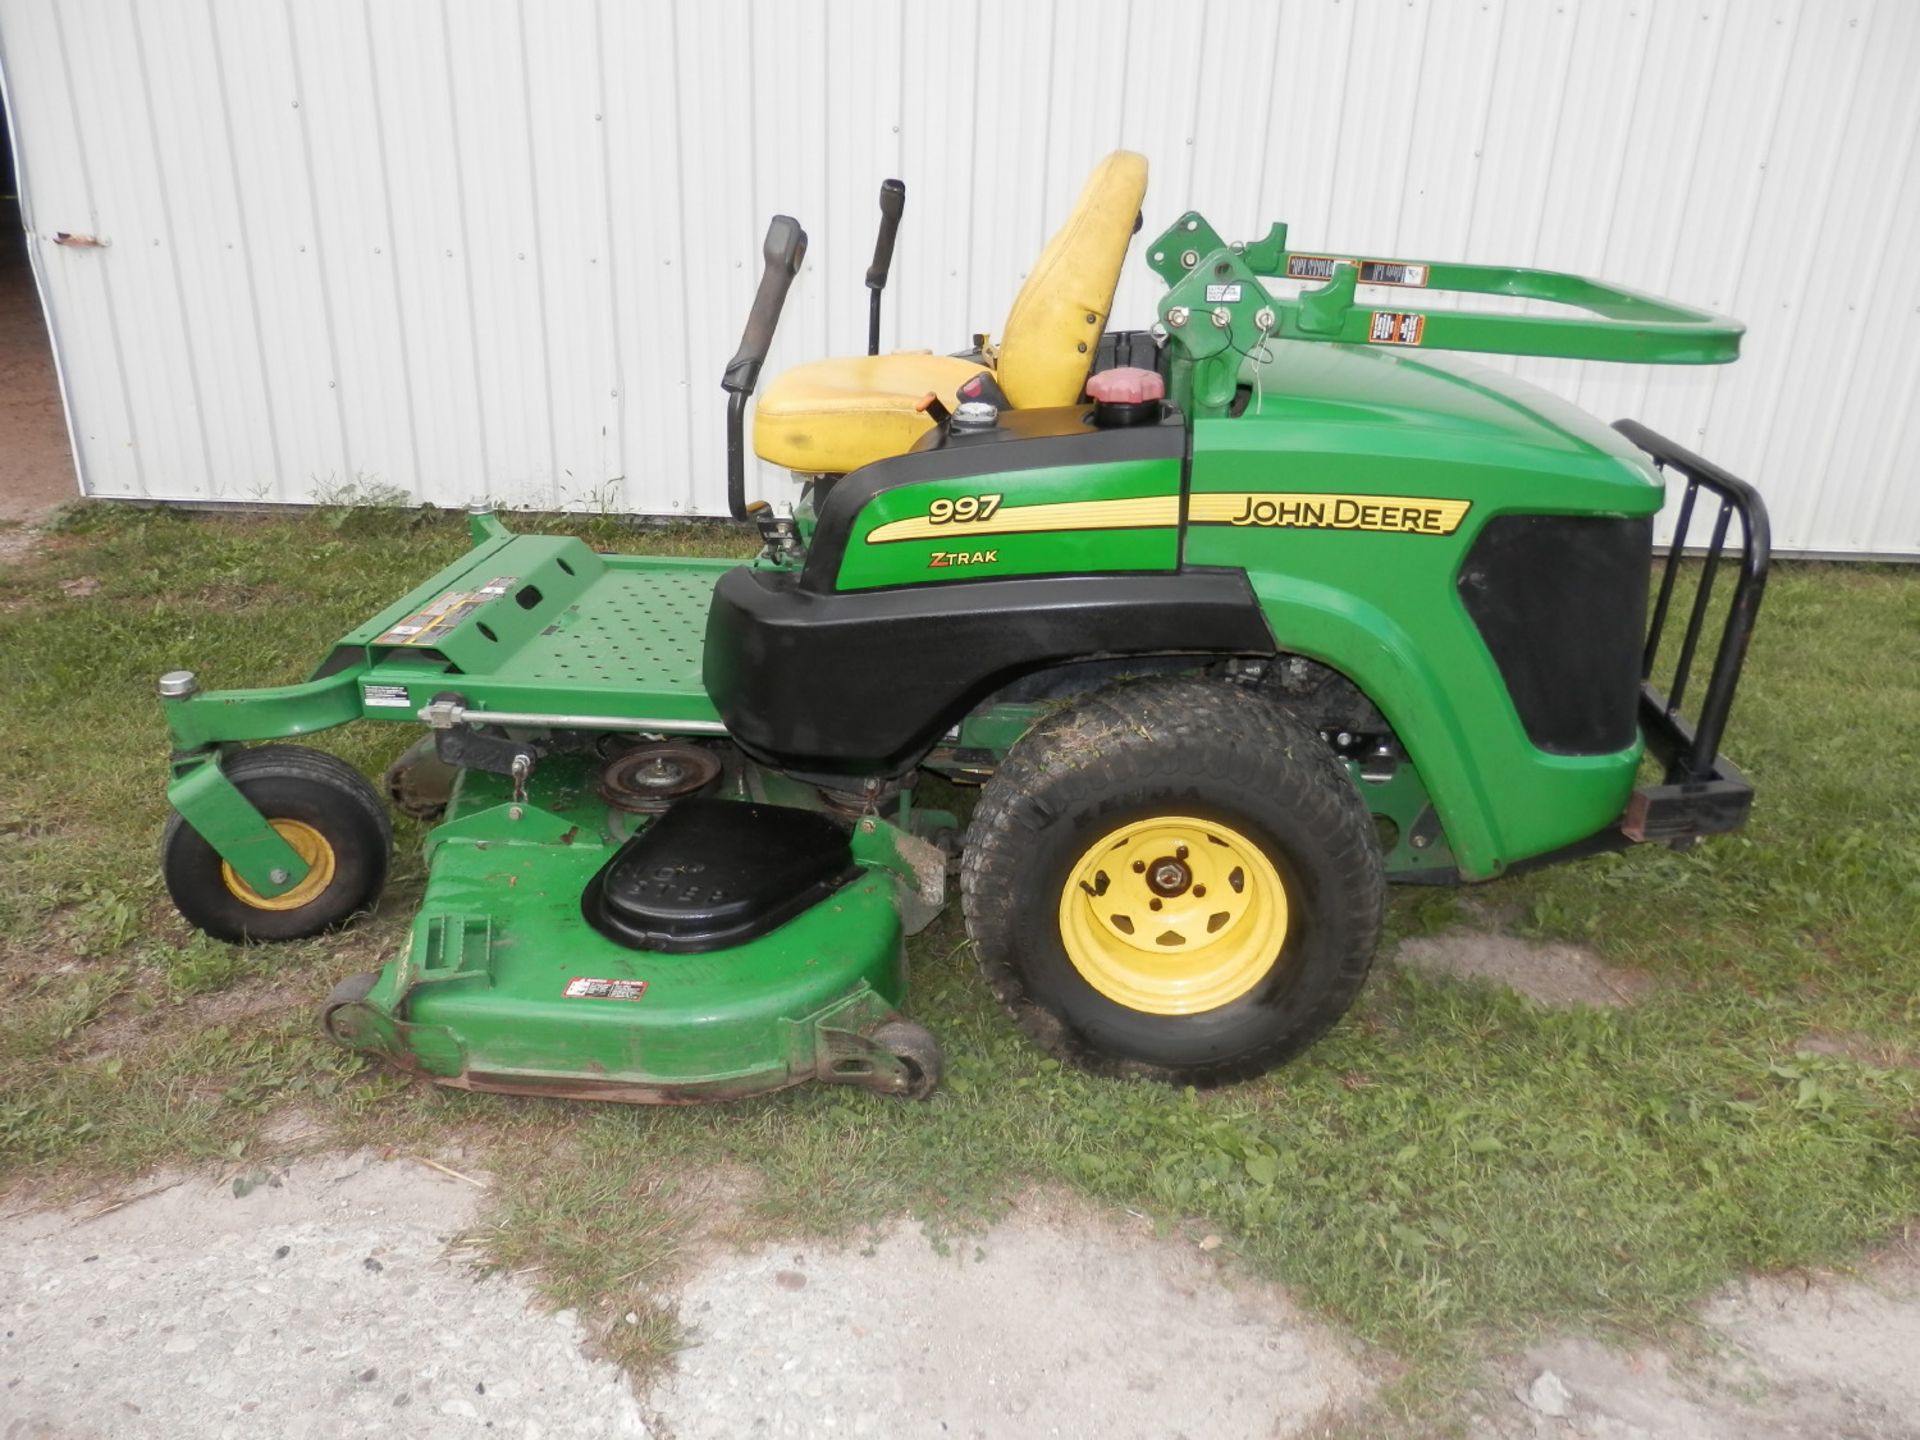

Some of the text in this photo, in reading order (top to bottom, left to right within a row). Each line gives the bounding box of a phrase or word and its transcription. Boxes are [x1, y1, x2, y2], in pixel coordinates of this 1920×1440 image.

[929, 493, 1003, 525] 997
[1232, 496, 1442, 530] JOHN DEERE
